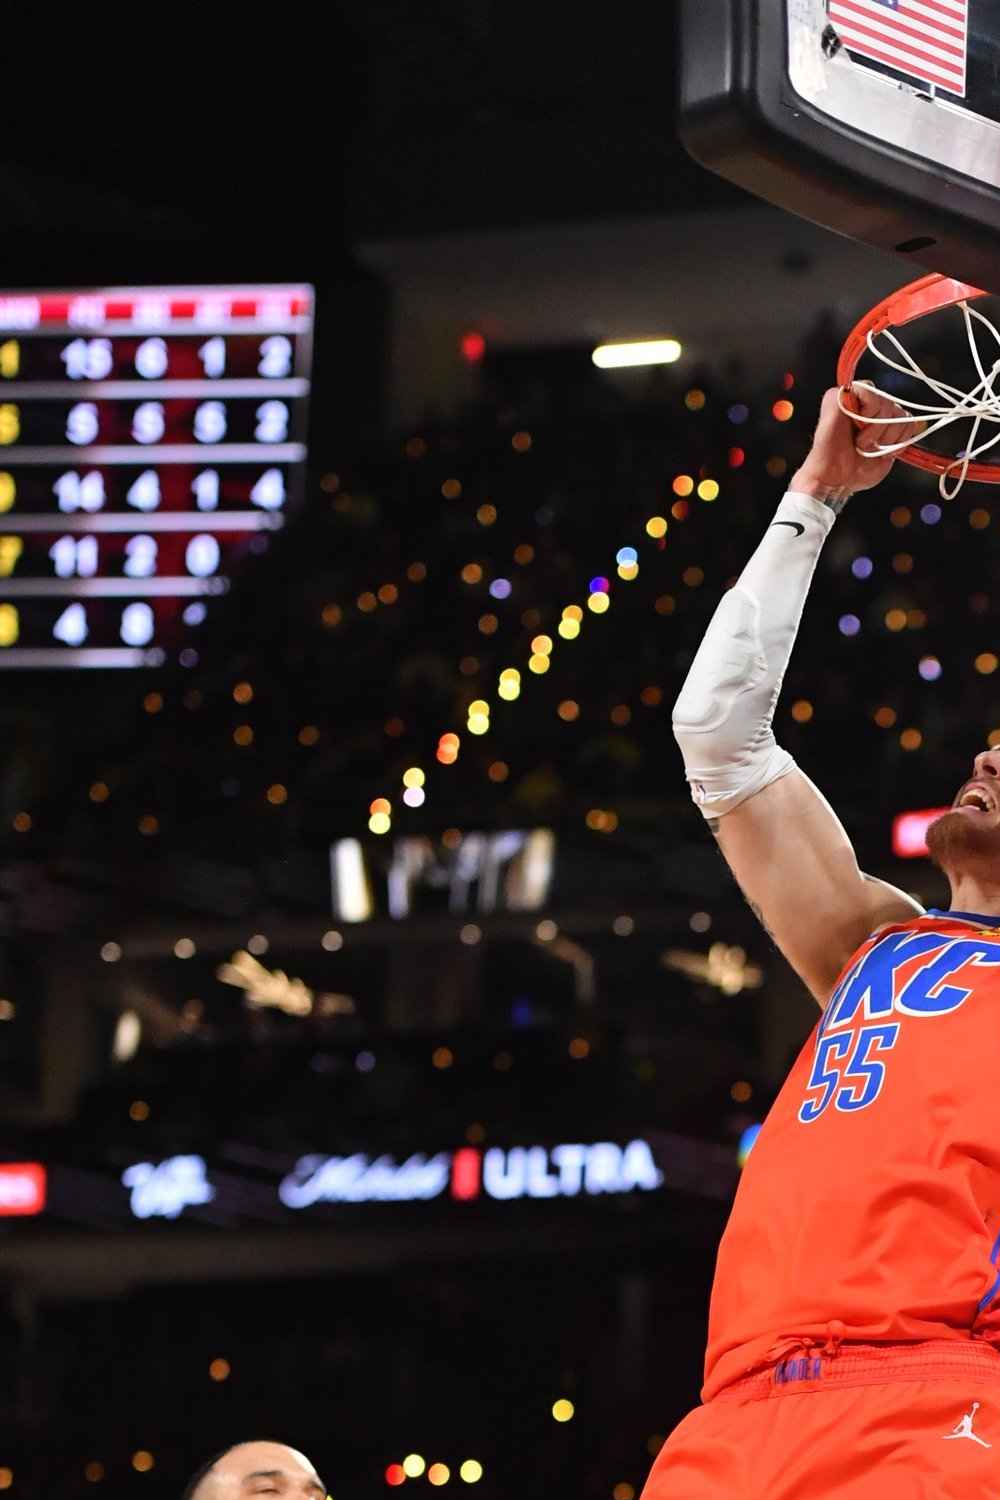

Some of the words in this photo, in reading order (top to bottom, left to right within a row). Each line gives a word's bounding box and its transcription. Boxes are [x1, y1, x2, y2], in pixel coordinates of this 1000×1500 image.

[198, 336, 226, 378] 1
[126, 470, 160, 512] 4
[191, 469, 219, 511] 1
[250, 468, 285, 511] 4
[53, 602, 88, 646] 4
[798, 1022, 900, 1124] 55
[483, 1139, 664, 1200] ULTRA
